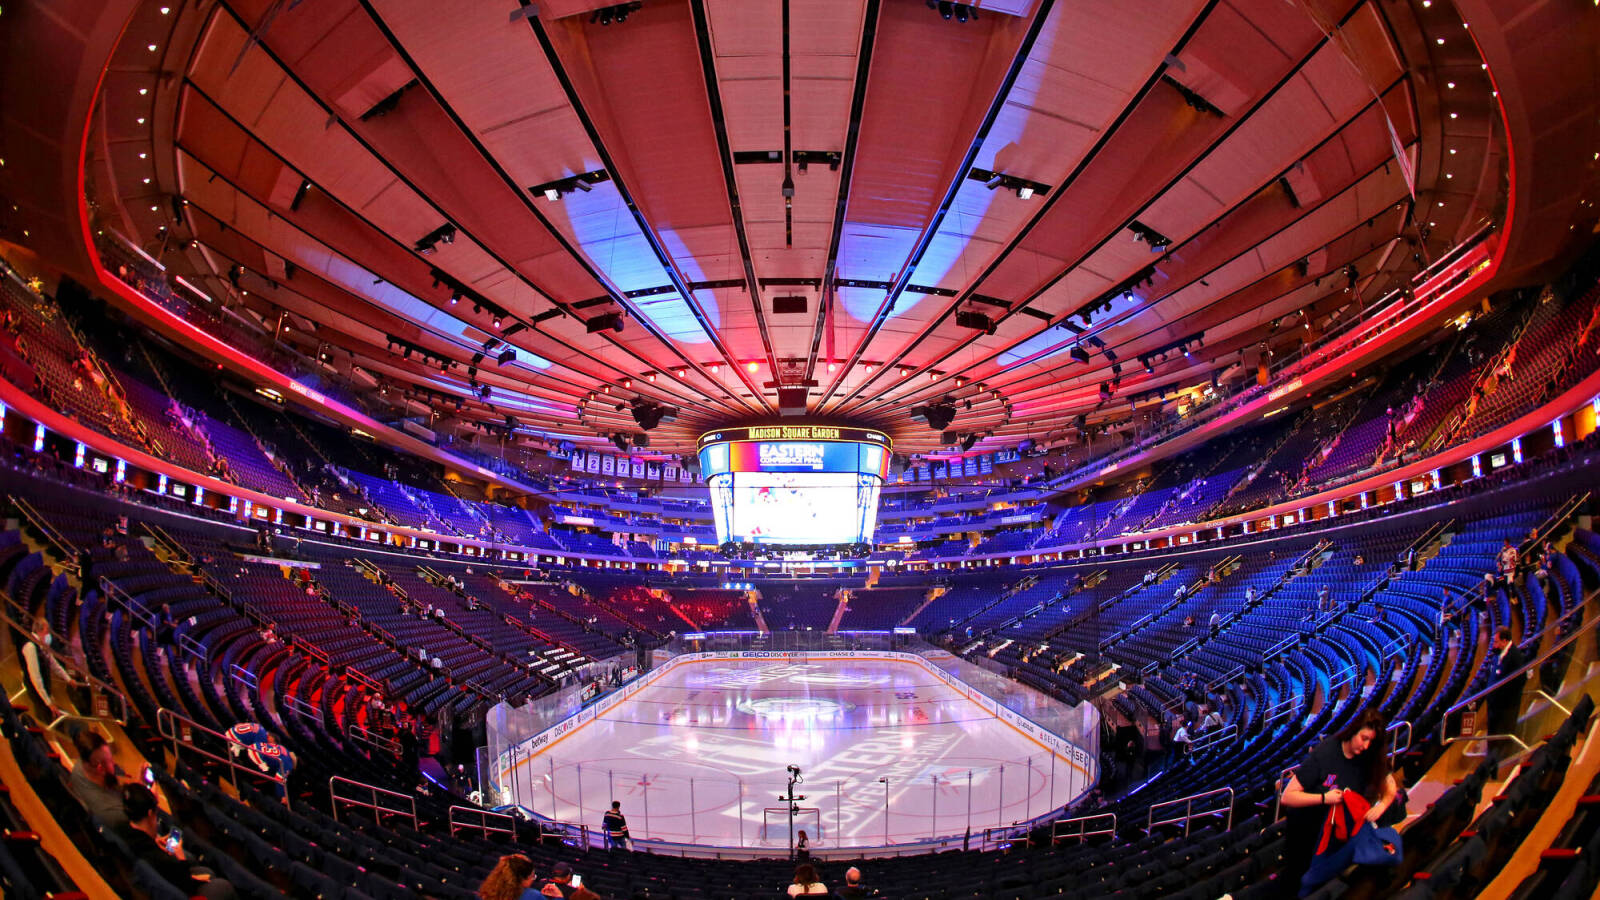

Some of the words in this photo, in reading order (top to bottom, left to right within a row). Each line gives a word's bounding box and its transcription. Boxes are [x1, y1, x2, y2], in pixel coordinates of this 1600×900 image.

[749, 427, 781, 439] MADISON
[782, 427, 810, 439] SQUARE
[811, 427, 840, 439] GARDEN
[760, 444, 824, 458] EASTERN
[554, 719, 574, 738] DISCOVER
[531, 734, 549, 748] betway
[1043, 733, 1060, 748] DELTA
[1065, 745, 1084, 763] CHASE
